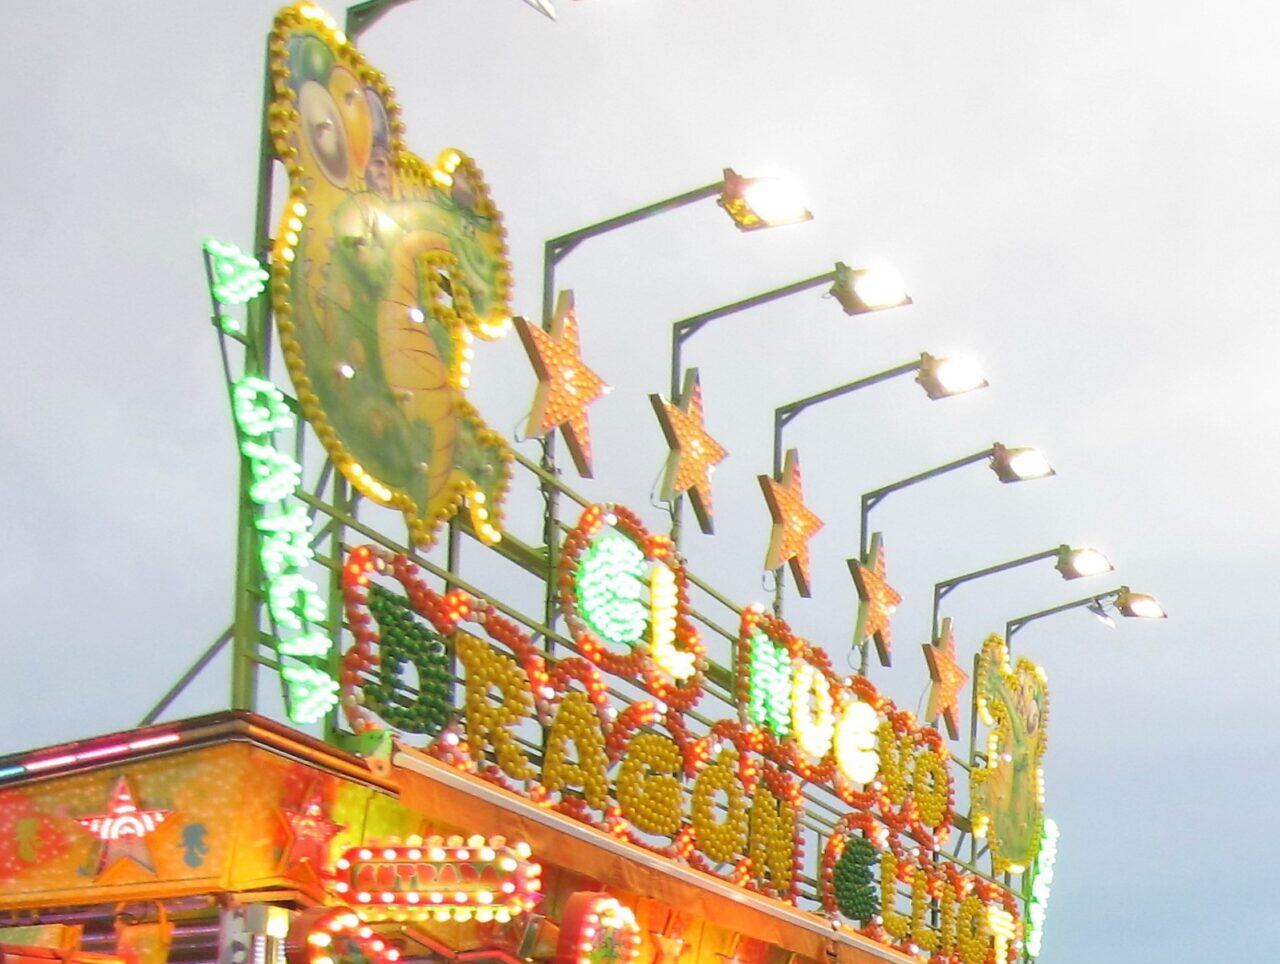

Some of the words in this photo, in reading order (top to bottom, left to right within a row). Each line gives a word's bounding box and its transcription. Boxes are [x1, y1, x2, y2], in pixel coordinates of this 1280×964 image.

[363, 584, 796, 895] DRAGON
[574, 533, 698, 681] EL
[750, 630, 950, 828] NUEVO
